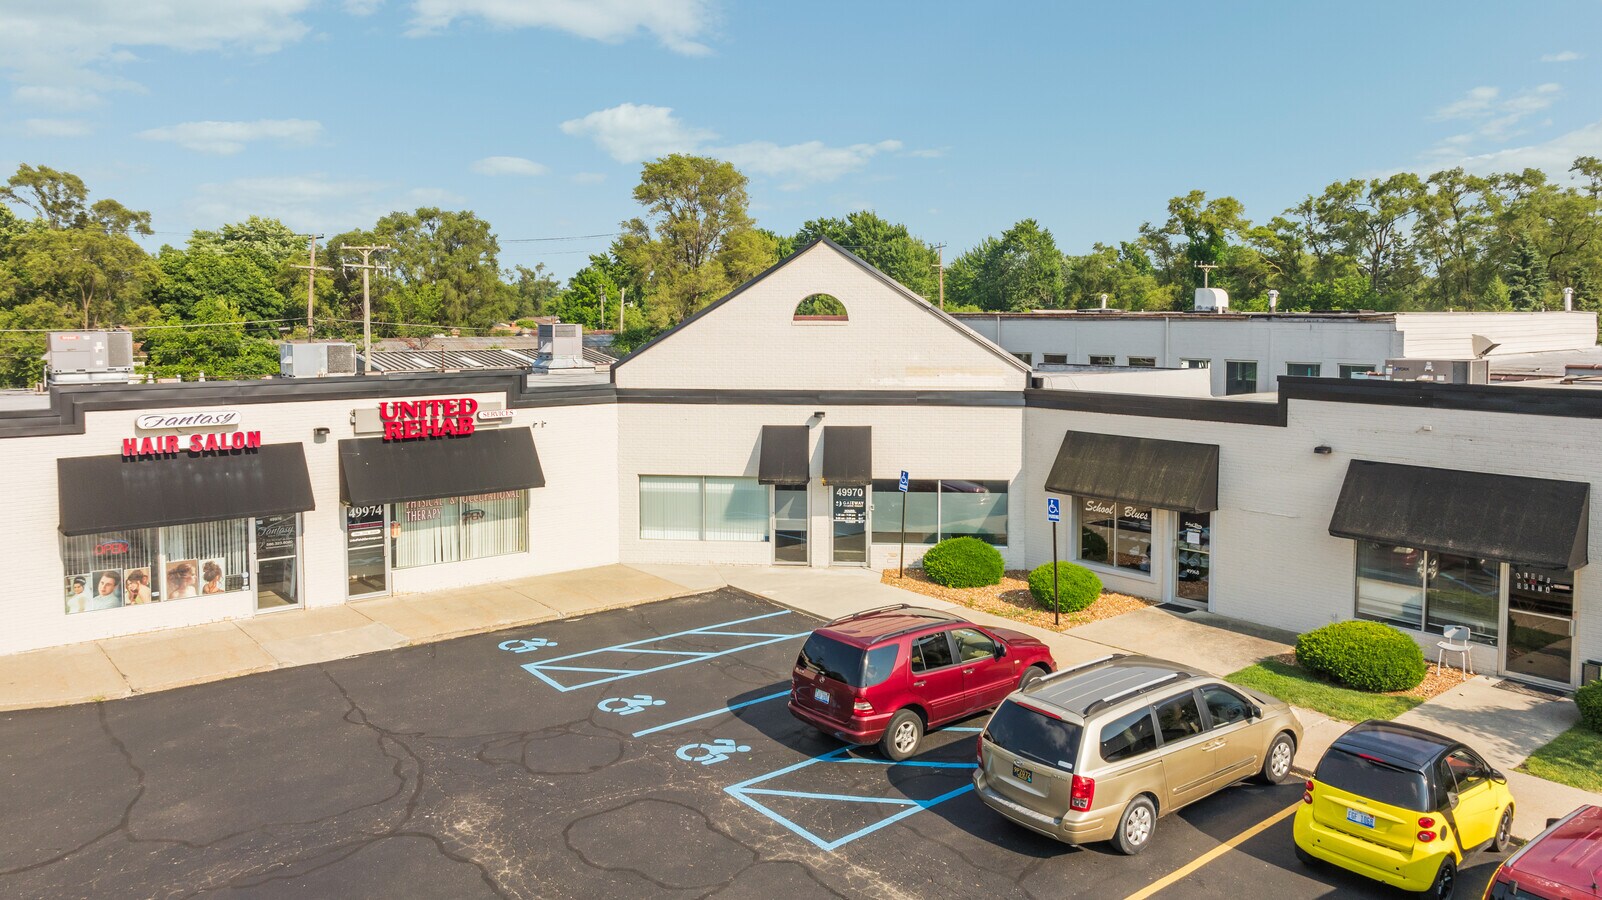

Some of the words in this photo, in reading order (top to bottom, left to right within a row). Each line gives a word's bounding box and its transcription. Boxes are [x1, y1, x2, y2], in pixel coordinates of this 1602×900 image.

[380, 398, 477, 420] UNITED
[482, 410, 514, 418] SERVICES
[144, 412, 236, 428] Fantasy
[383, 417, 475, 440] REHAB
[123, 435, 180, 456] HAIR
[189, 430, 261, 452] SALON
[836, 488, 863, 496] 49970
[348, 505, 382, 518] 49974
[406, 509, 441, 521] THERAPY
[1085, 500, 1115, 515] School
[1124, 506, 1149, 520] Blues
[95, 542, 129, 555] OPEN
